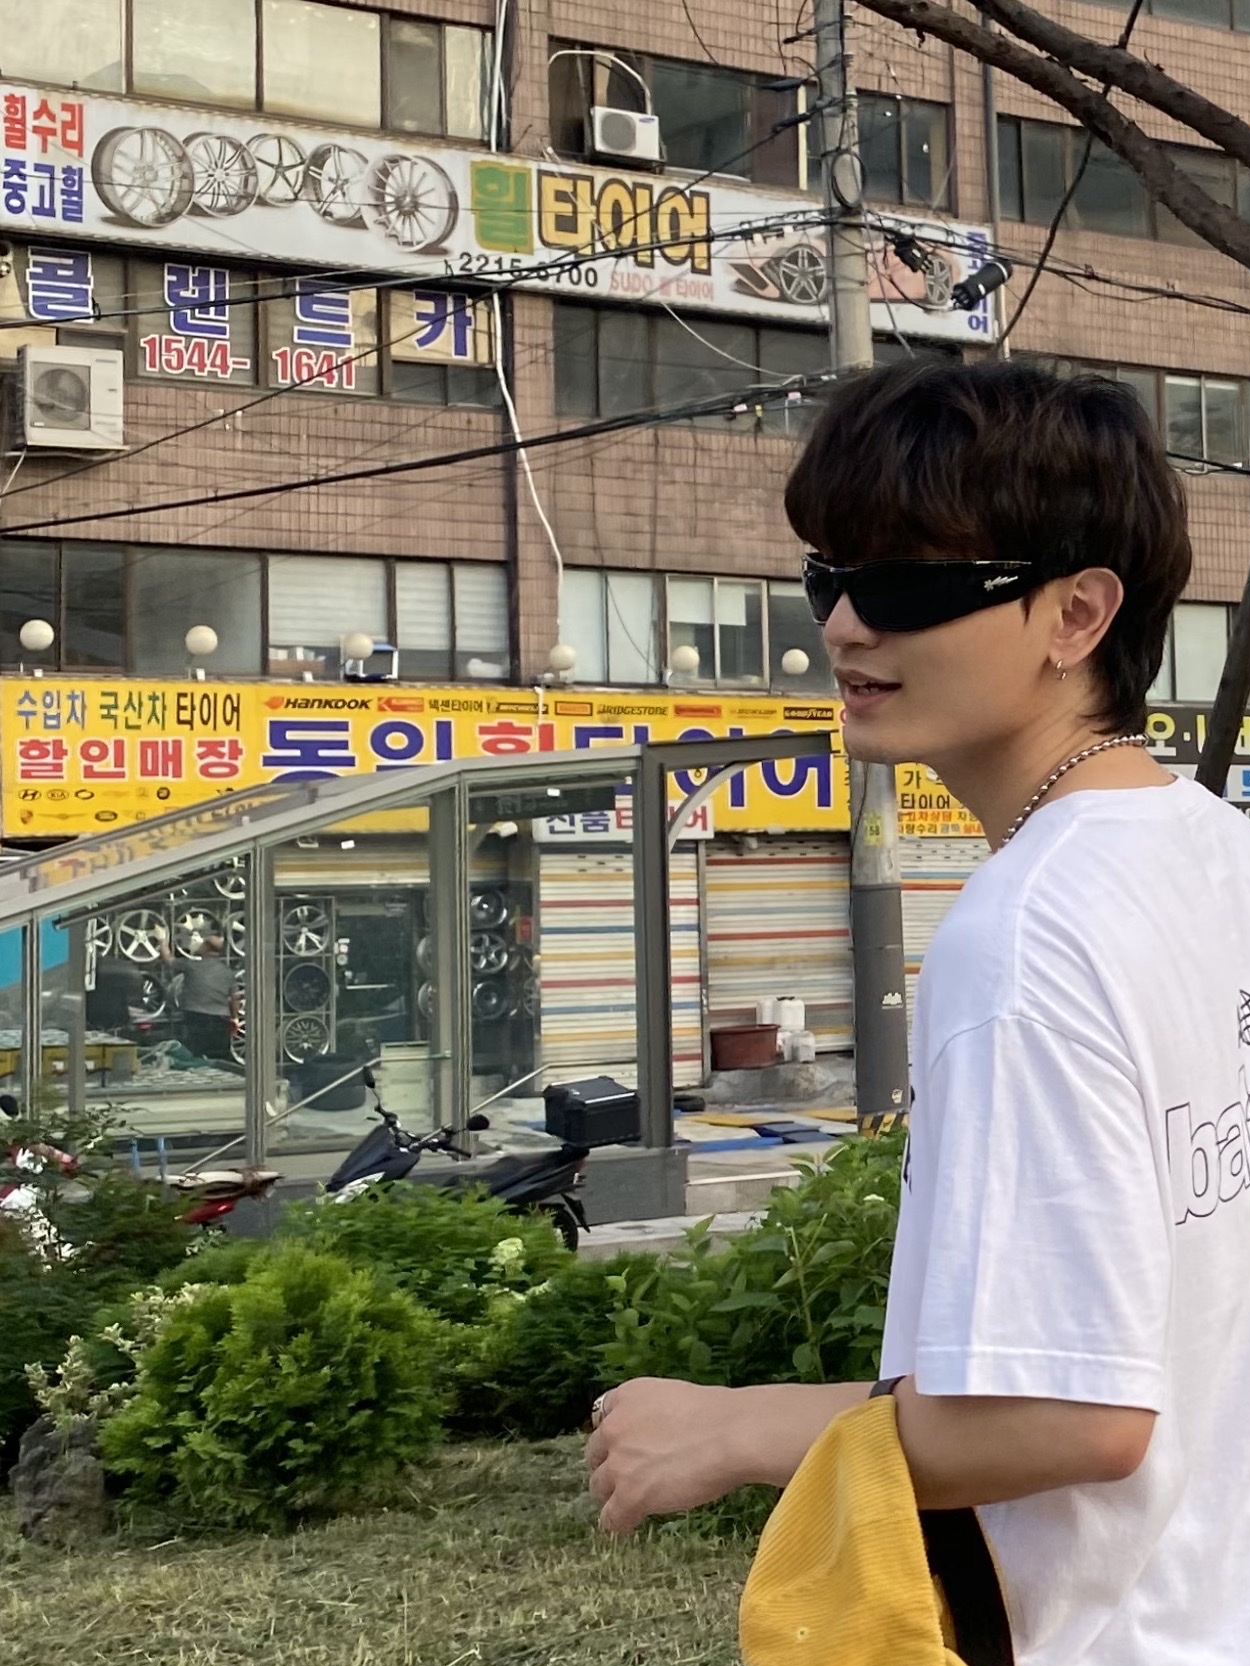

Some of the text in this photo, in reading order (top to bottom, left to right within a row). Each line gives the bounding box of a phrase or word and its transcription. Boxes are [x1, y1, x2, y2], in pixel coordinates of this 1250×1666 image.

[4, 93, 83, 158] 휠수리
[3, 158, 83, 223] 중고휠
[537, 168, 712, 276] 타이어
[273, 347, 356, 389] 1641
[17, 689, 241, 732] 수입차 국산차 타이어
[19, 738, 243, 780] 할인매장
[901, 793, 950, 809] 타이어
